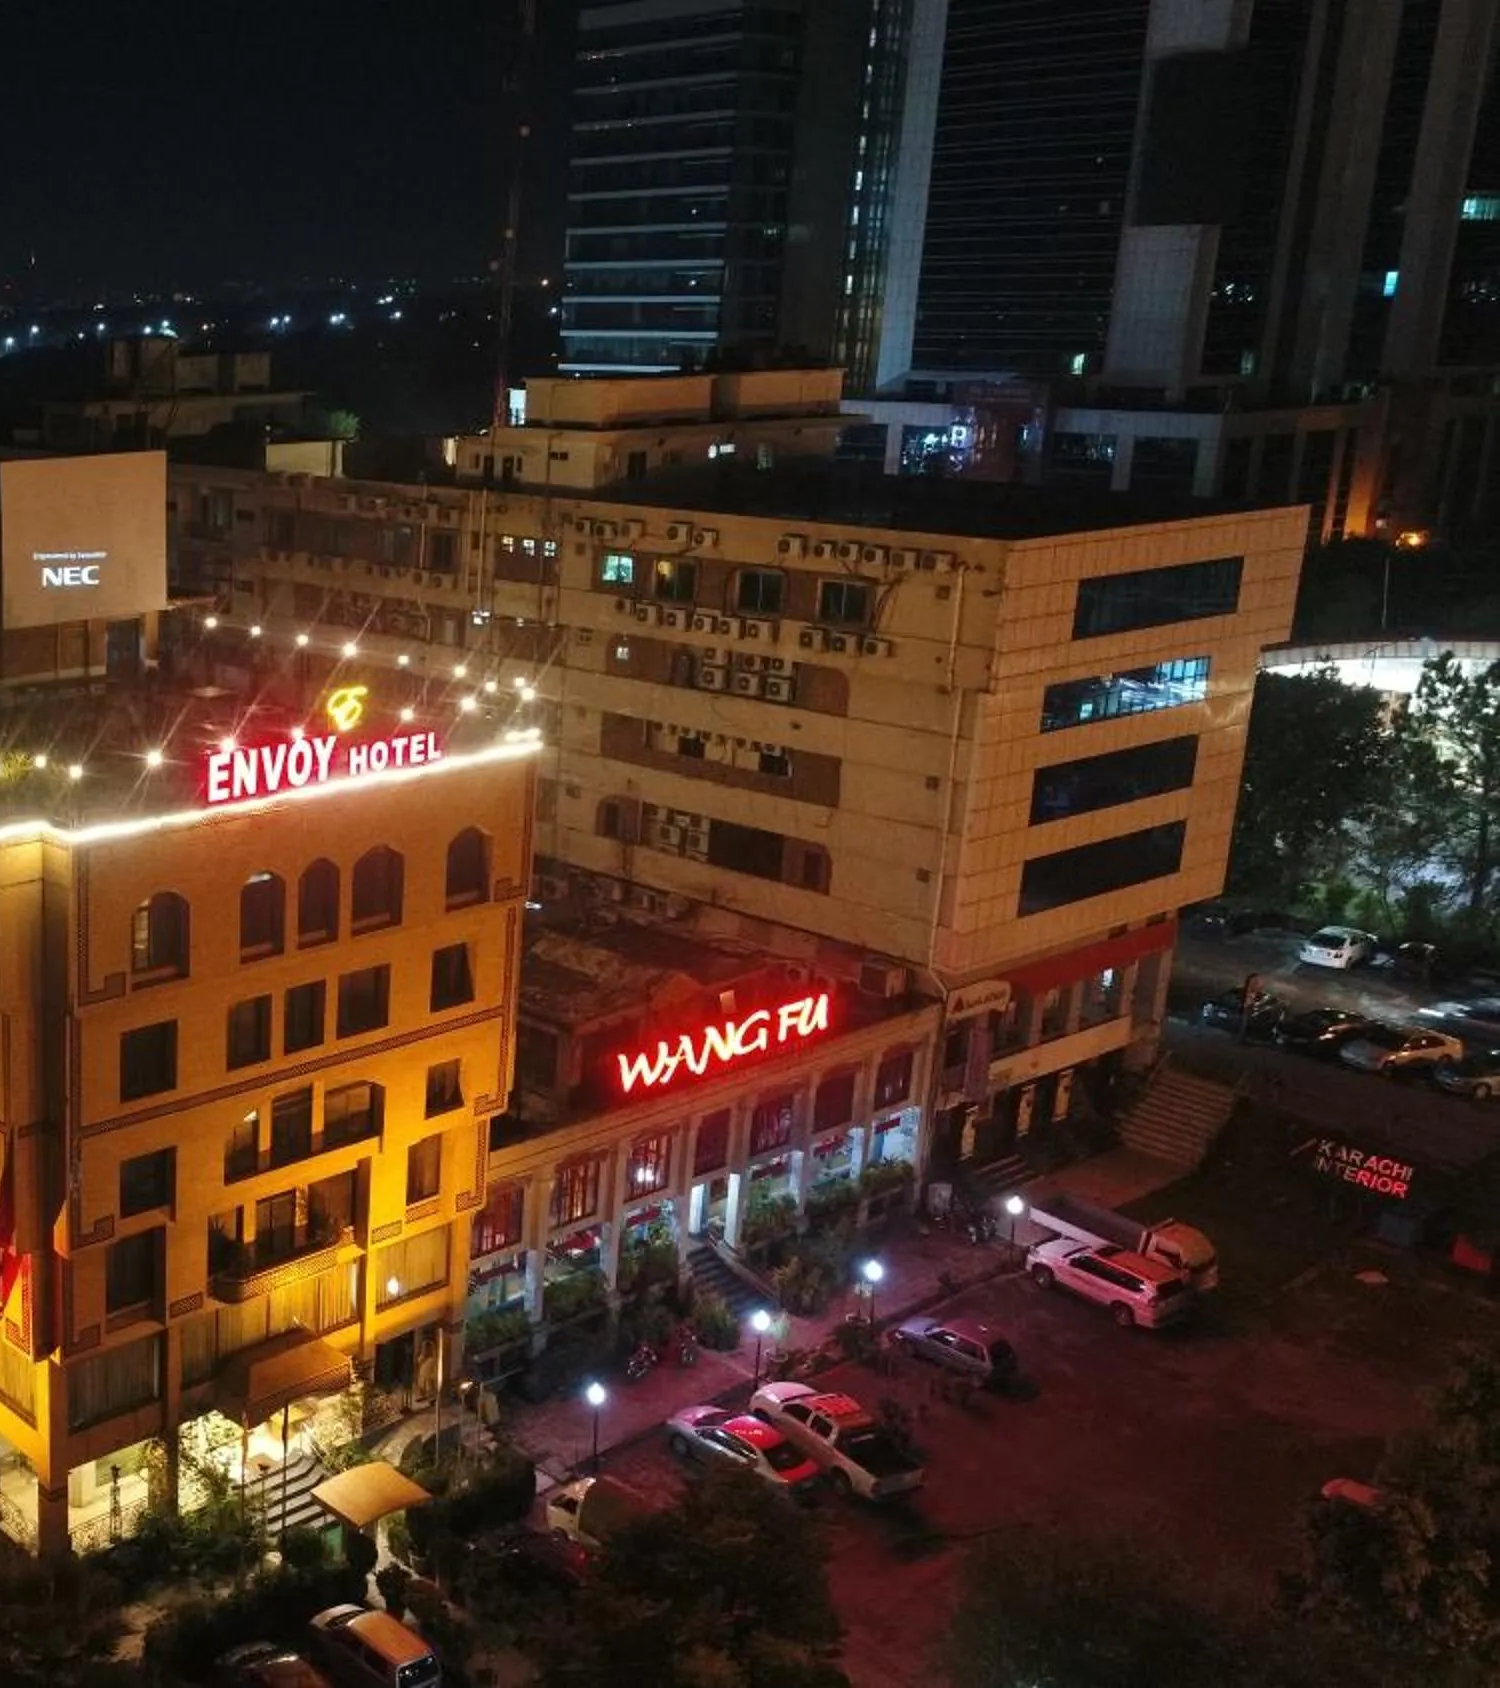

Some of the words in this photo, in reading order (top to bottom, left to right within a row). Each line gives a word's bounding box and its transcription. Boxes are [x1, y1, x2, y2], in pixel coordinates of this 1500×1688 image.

[42, 565, 100, 587] NEC
[208, 735, 336, 802] ENVOY
[350, 732, 441, 776] HOTEL
[617, 1009, 771, 1093] WANG
[778, 993, 828, 1042] FU
[1314, 1155, 1408, 1199] INTERIOR
[1319, 1140, 1414, 1181] KARACHI
